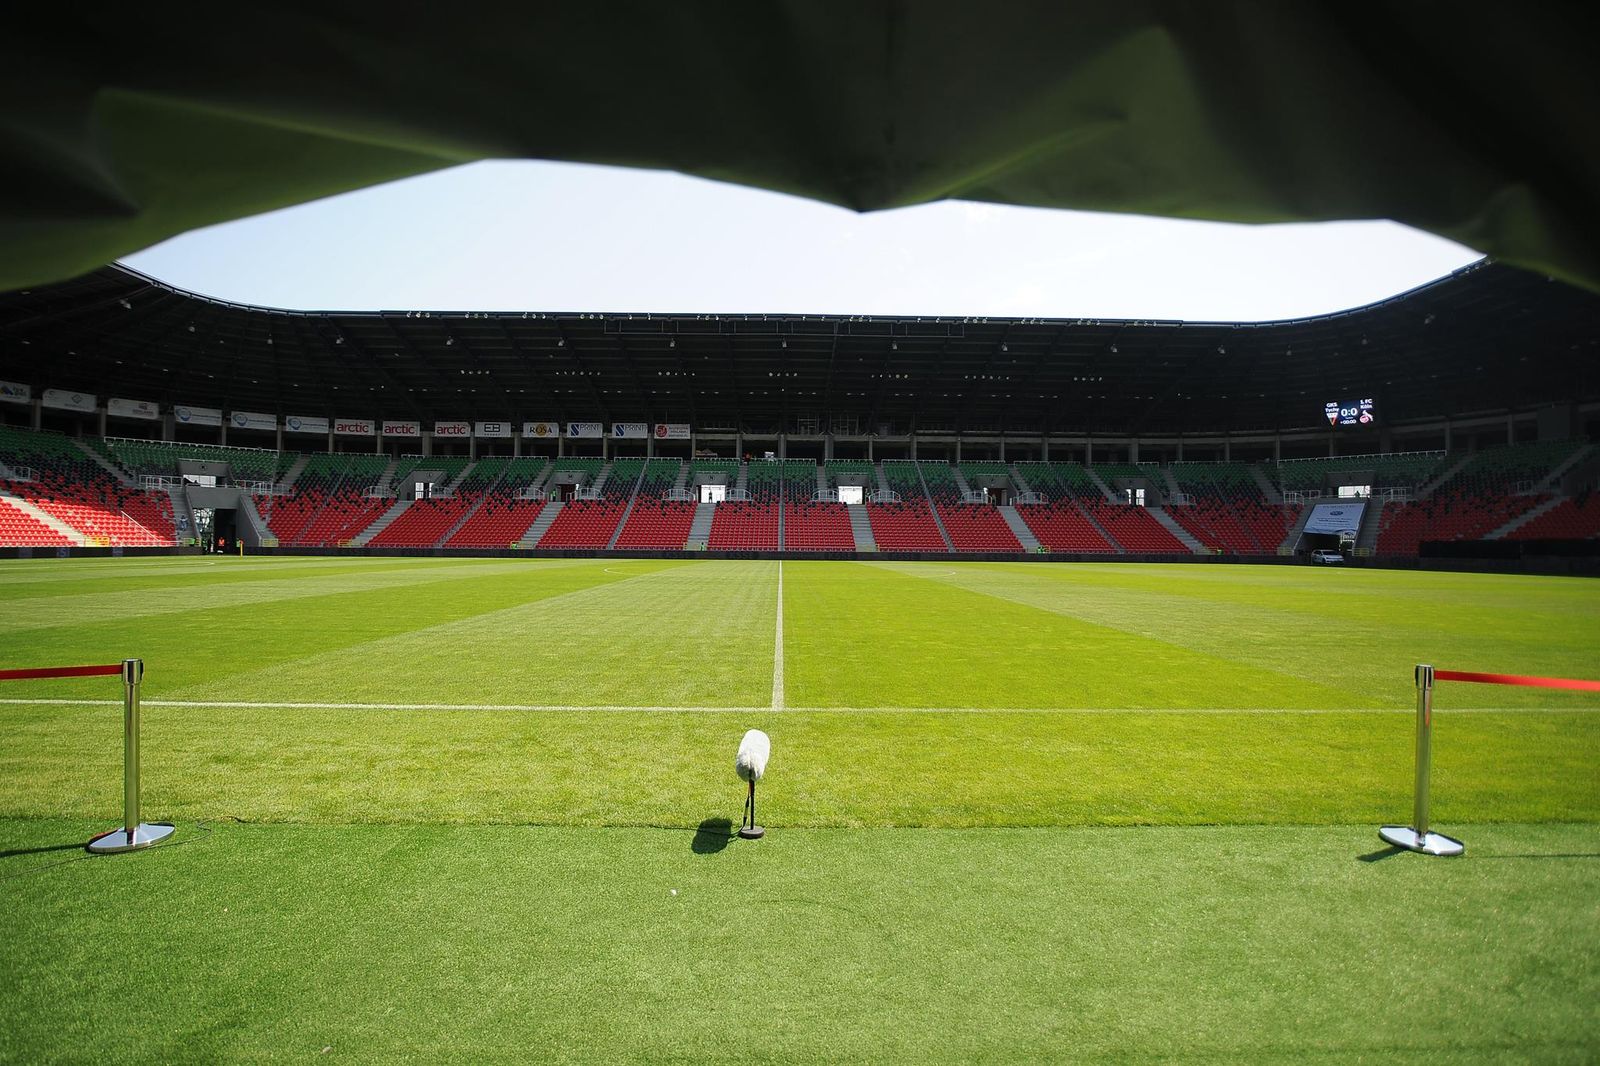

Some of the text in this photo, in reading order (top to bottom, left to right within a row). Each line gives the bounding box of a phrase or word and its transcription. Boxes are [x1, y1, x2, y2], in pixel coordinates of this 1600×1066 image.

[1341, 408, 1358, 417] 0:0
[336, 422, 370, 433] arctic
[384, 423, 415, 434] arctic
[436, 424, 466, 434] arctic
[529, 426, 553, 434] ROSA
